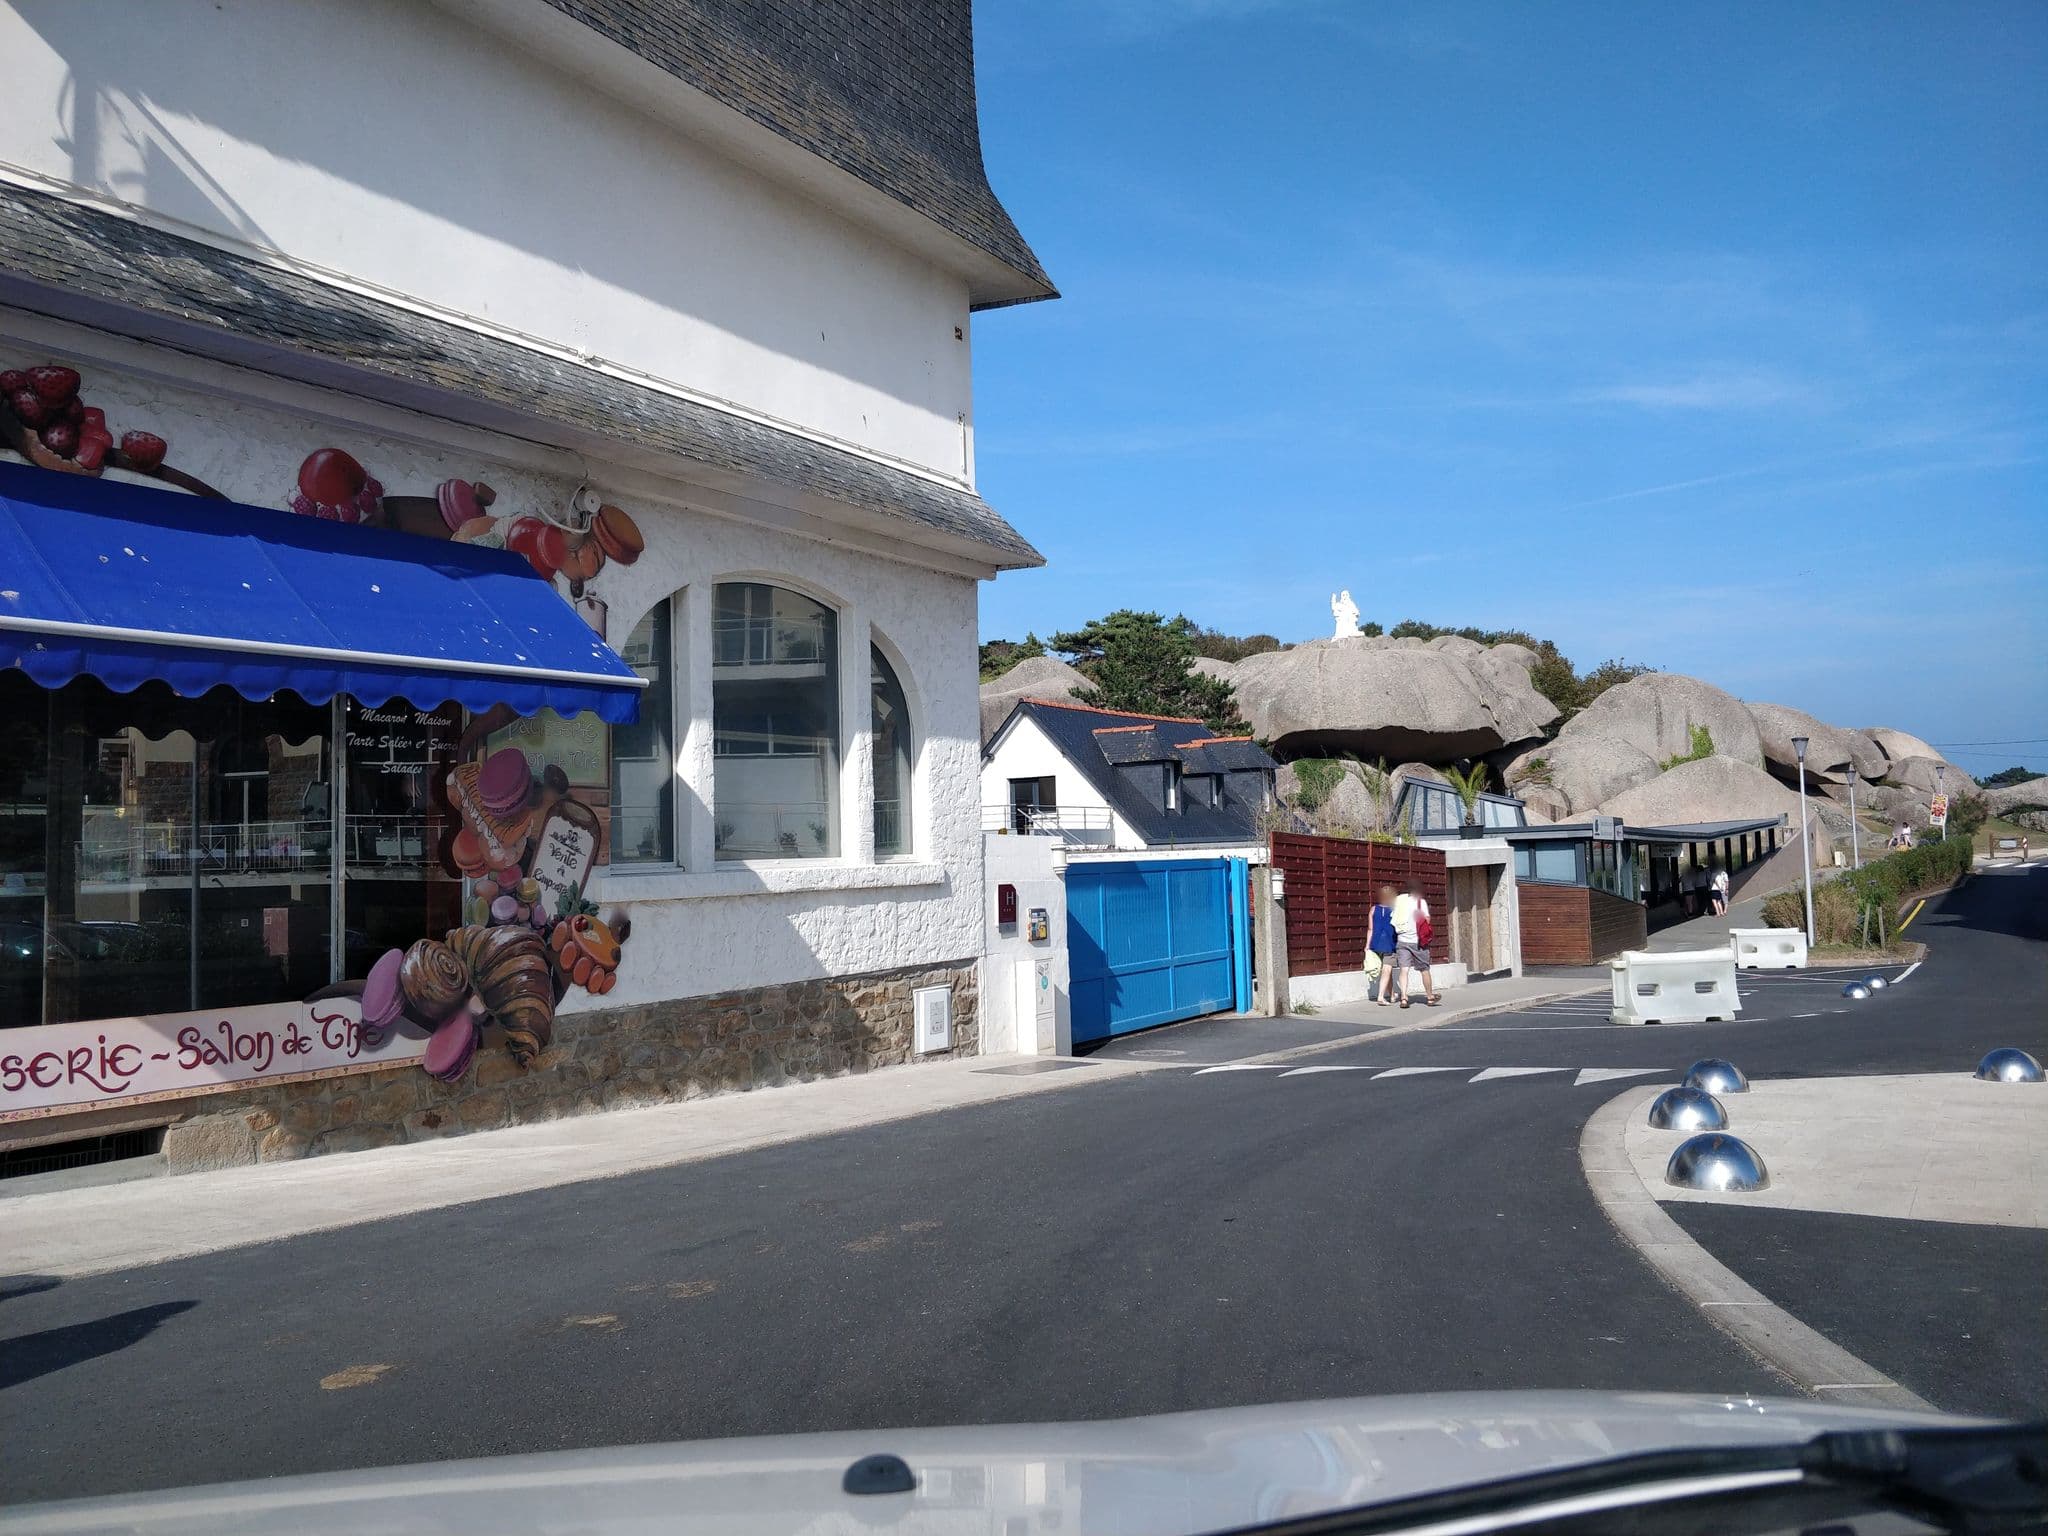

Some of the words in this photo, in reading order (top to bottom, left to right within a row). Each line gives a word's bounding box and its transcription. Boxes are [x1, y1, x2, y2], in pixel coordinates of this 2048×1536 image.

[360, 708, 406, 723] Macaron
[414, 711, 452, 726] Maison
[346, 732, 375, 746] Tarte
[380, 761, 423, 774] Salades
[177, 1020, 274, 1072] Salon
[281, 1022, 313, 1055] de
